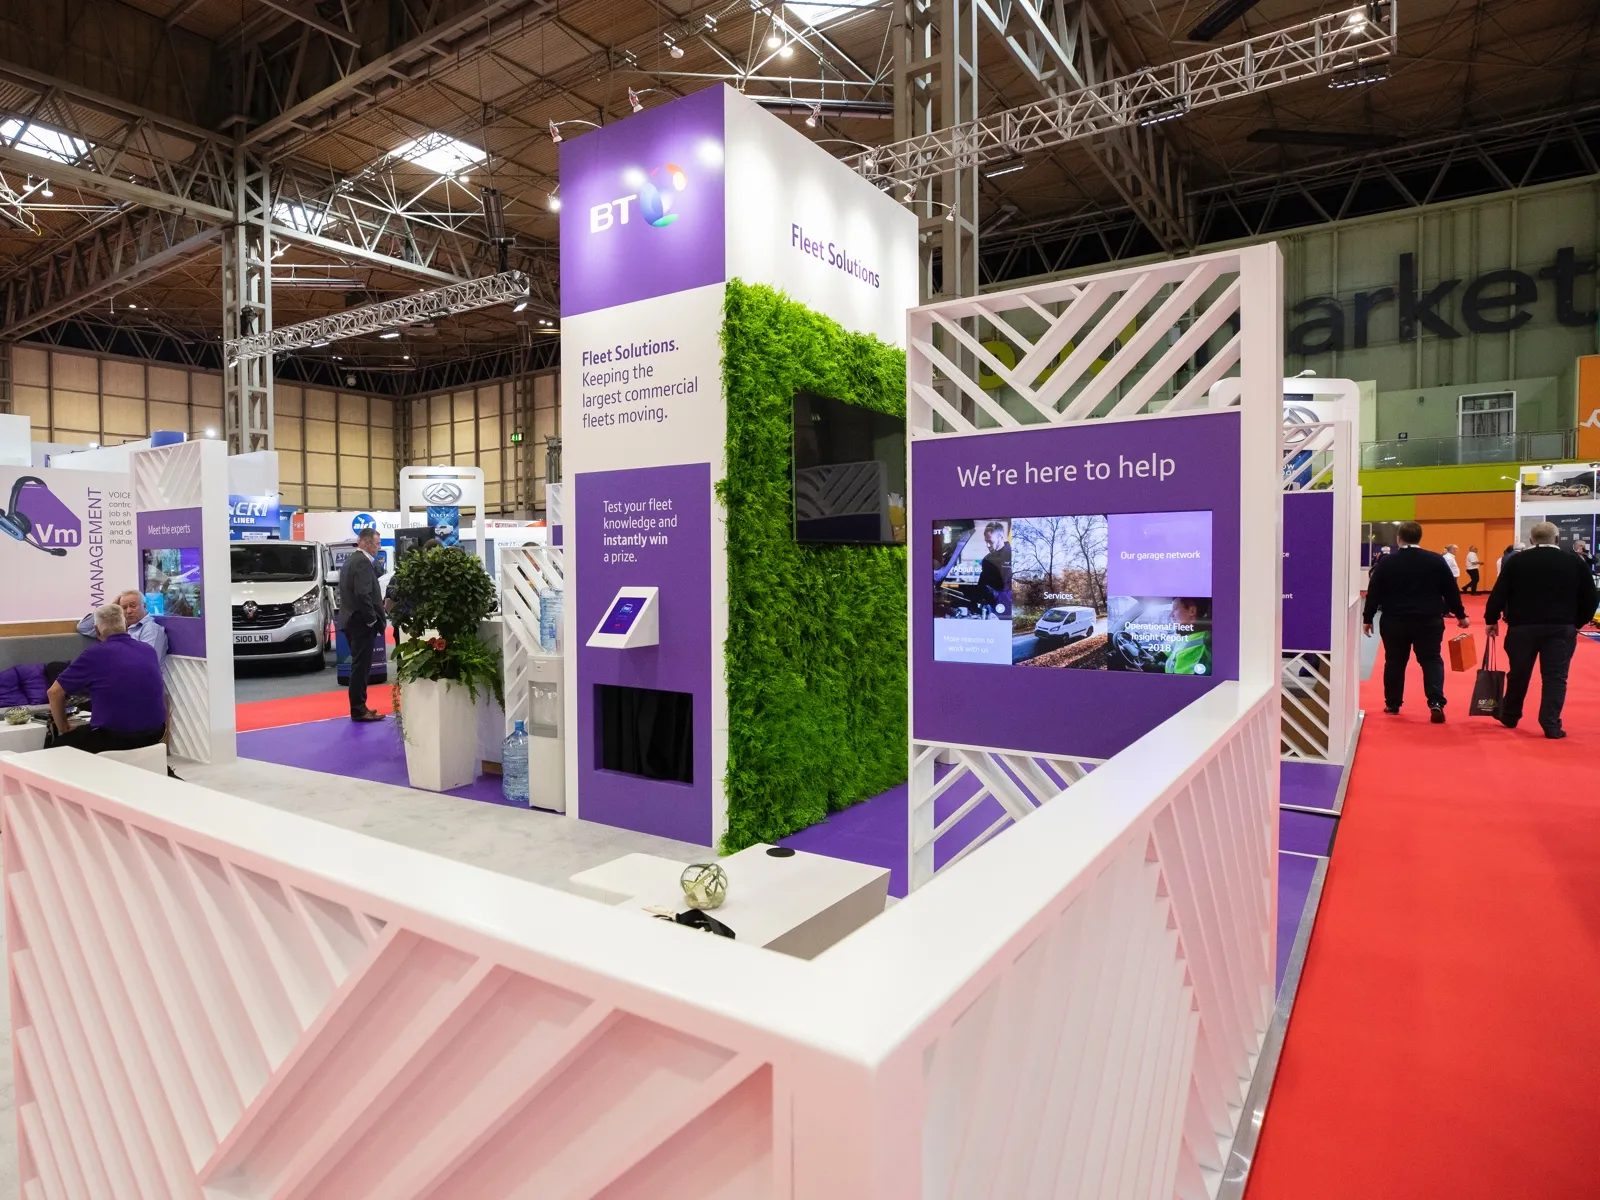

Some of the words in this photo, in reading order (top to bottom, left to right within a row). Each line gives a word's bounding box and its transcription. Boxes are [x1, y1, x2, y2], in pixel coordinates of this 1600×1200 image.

[589, 194, 638, 234] BT
[792, 222, 825, 261] Fleet
[828, 242, 880, 289] Solutions
[1286, 247, 1600, 356] arket
[582, 349, 613, 367] Fleet
[615, 339, 679, 361] Solutions.
[582, 368, 630, 388] Keeping
[632, 363, 654, 380] the
[582, 389, 622, 409] largest
[625, 376, 698, 402] commercial
[582, 413, 615, 429] fleets
[618, 405, 668, 424] moving.
[957, 464, 1018, 488] We’re
[1025, 462, 1078, 484] here
[1084, 459, 1111, 481] to
[1118, 453, 1176, 481] help
[108, 510, 121, 518] job
[603, 501, 622, 513] Test
[624, 502, 647, 515] your
[649, 498, 673, 511] fleet
[147, 525, 161, 535] Meet
[162, 524, 170, 534] the
[170, 524, 191, 535] experts
[603, 516, 656, 531] knowledge
[658, 514, 678, 528] and
[35, 523, 78, 544] Vm
[603, 532, 648, 548] instantly
[649, 532, 668, 545] win
[87, 487, 105, 608] MANAGEMENT
[1120, 550, 1136, 560] Our
[1136, 552, 1165, 561] garage
[1166, 550, 1201, 560] network
[603, 553, 609, 563] a
[611, 550, 638, 565] prize.
[953, 565, 974, 573] About
[1043, 591, 1073, 600] Services
[1124, 621, 1171, 632] Operational
[1173, 622, 1194, 632] Fleet
[254, 634, 269, 642] LNR
[943, 635, 959, 643] More
[960, 636, 986, 644] reasons
[986, 636, 994, 644] to
[1131, 633, 1159, 642] Insight
[1160, 633, 1189, 643] Report
[948, 645, 964, 653] work
[965, 645, 980, 653] with
[1148, 643, 1172, 652] 2018
